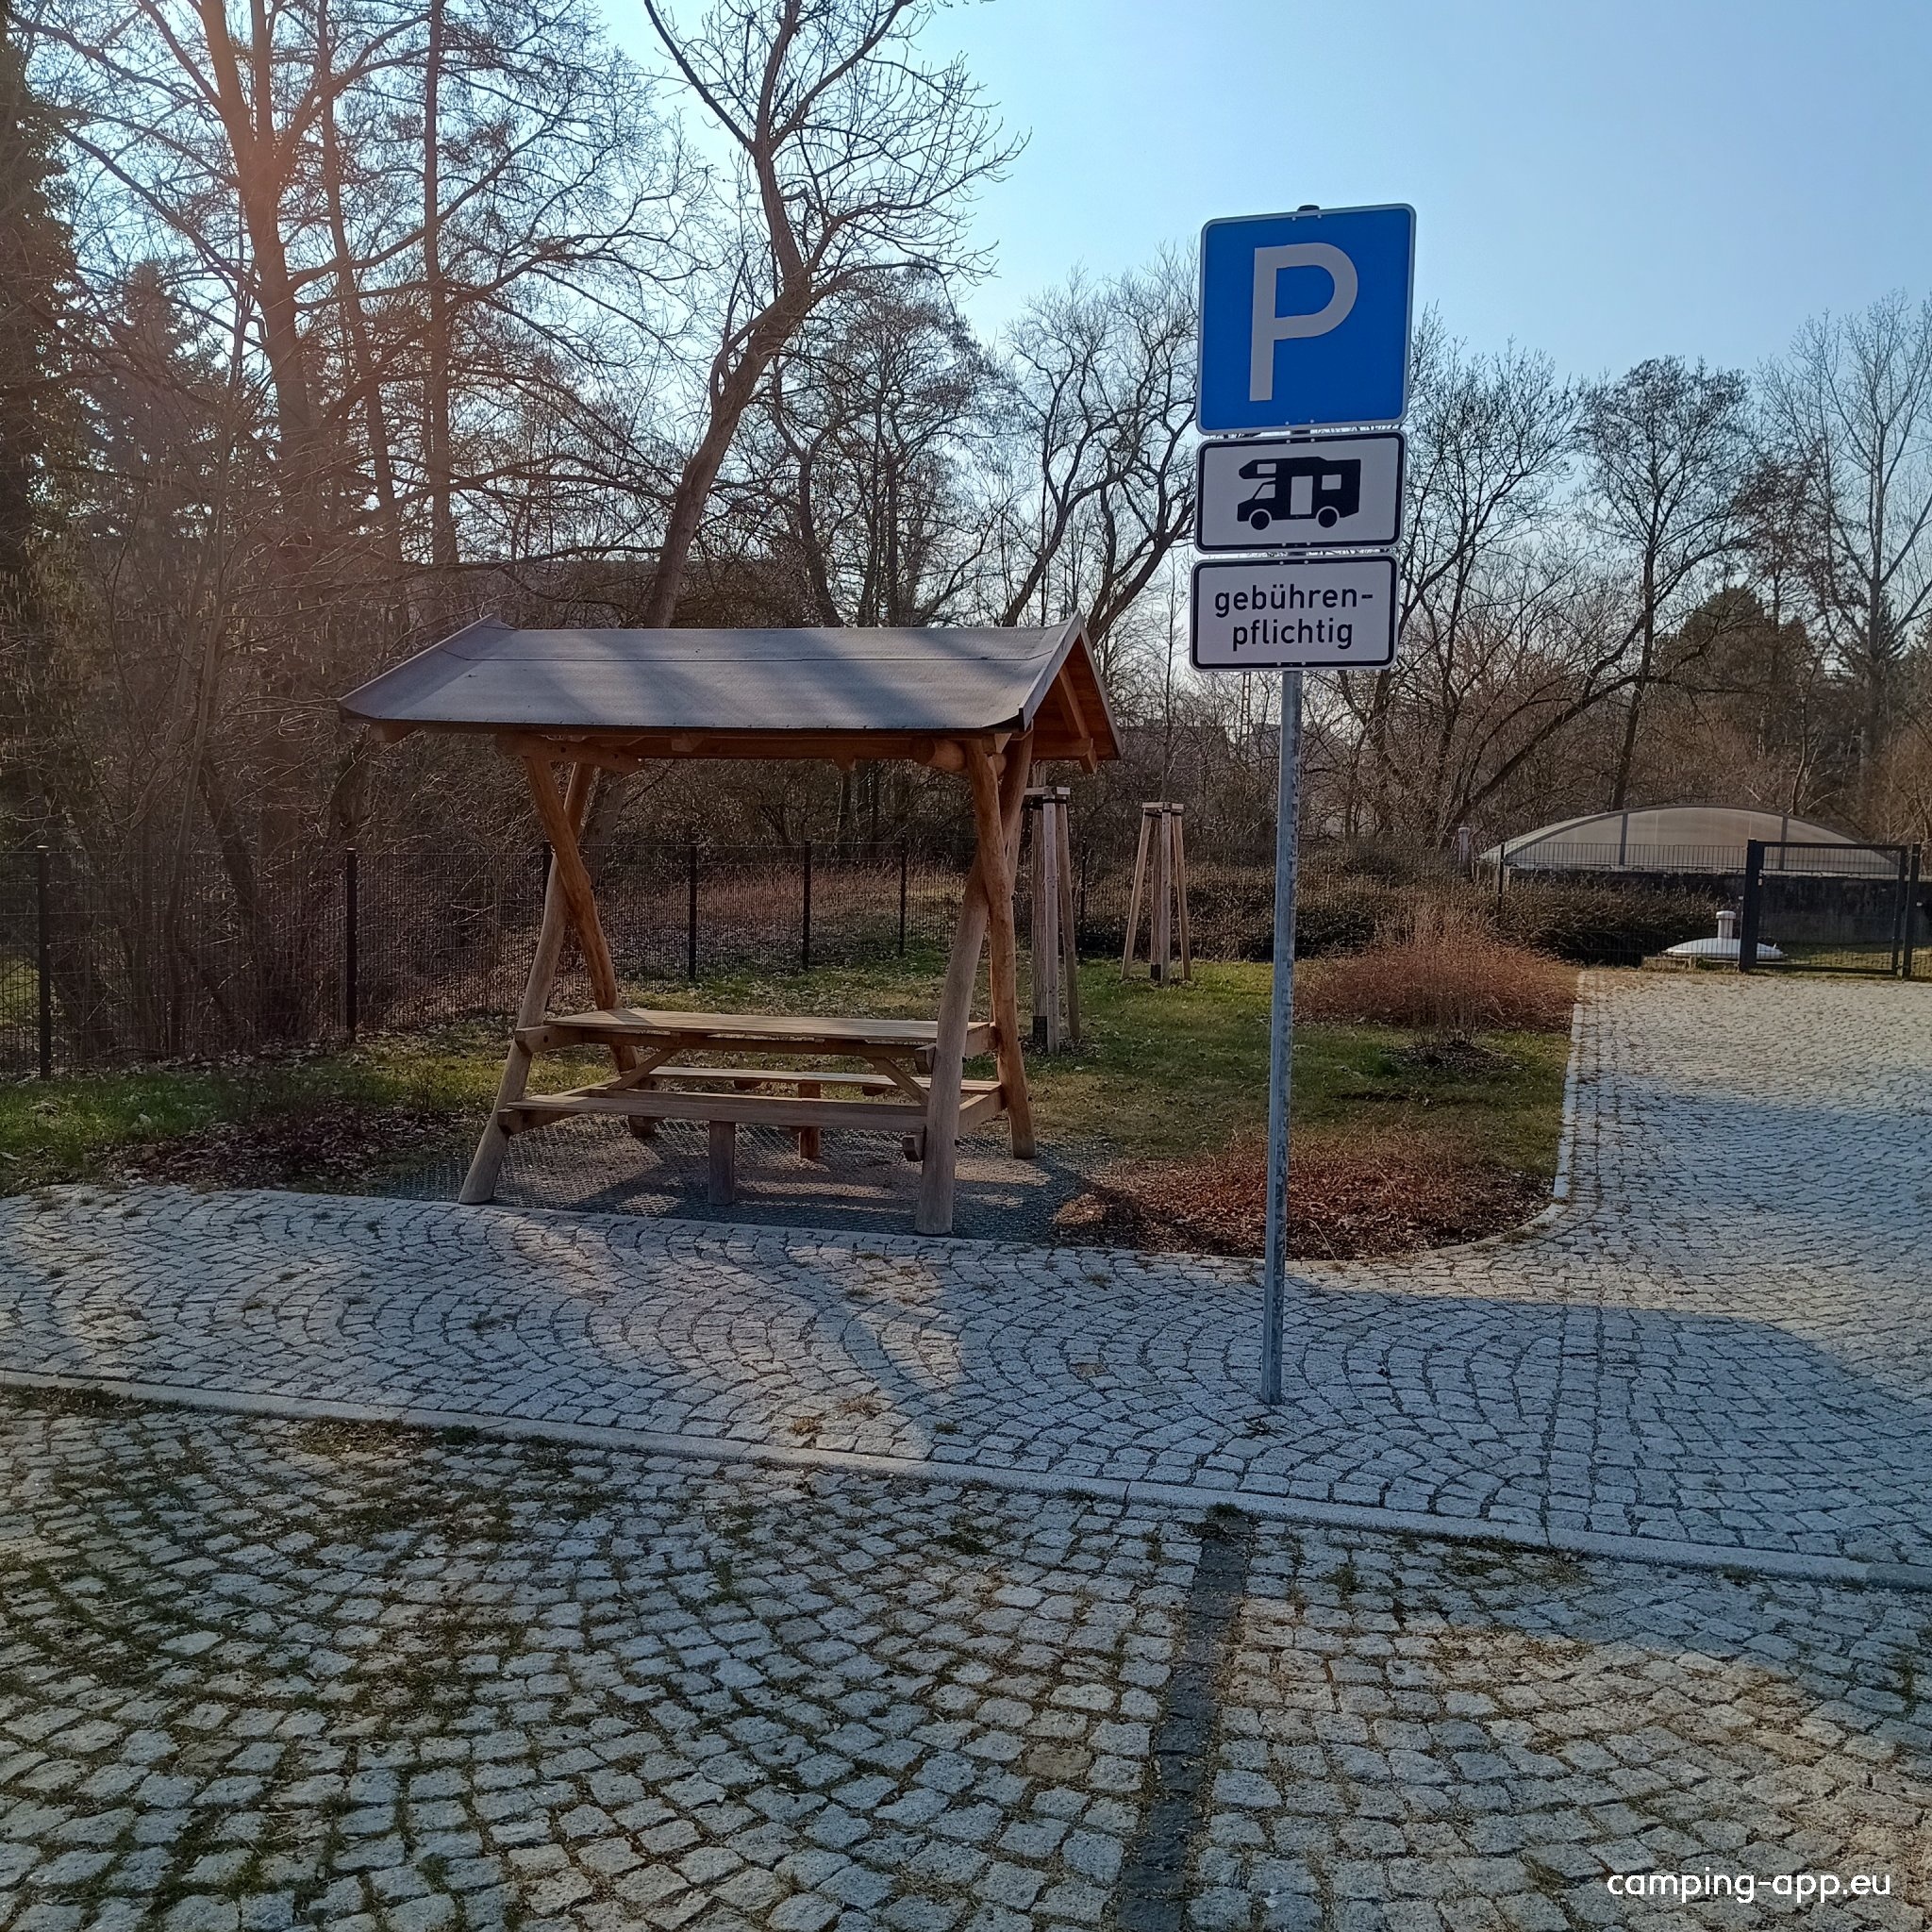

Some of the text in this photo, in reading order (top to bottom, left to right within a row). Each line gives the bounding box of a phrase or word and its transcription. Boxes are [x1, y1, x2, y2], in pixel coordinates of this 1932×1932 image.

[1250, 242, 1357, 401] P
[1214, 583, 1374, 618] gebühren-
[1232, 617, 1353, 651] pflichtig
